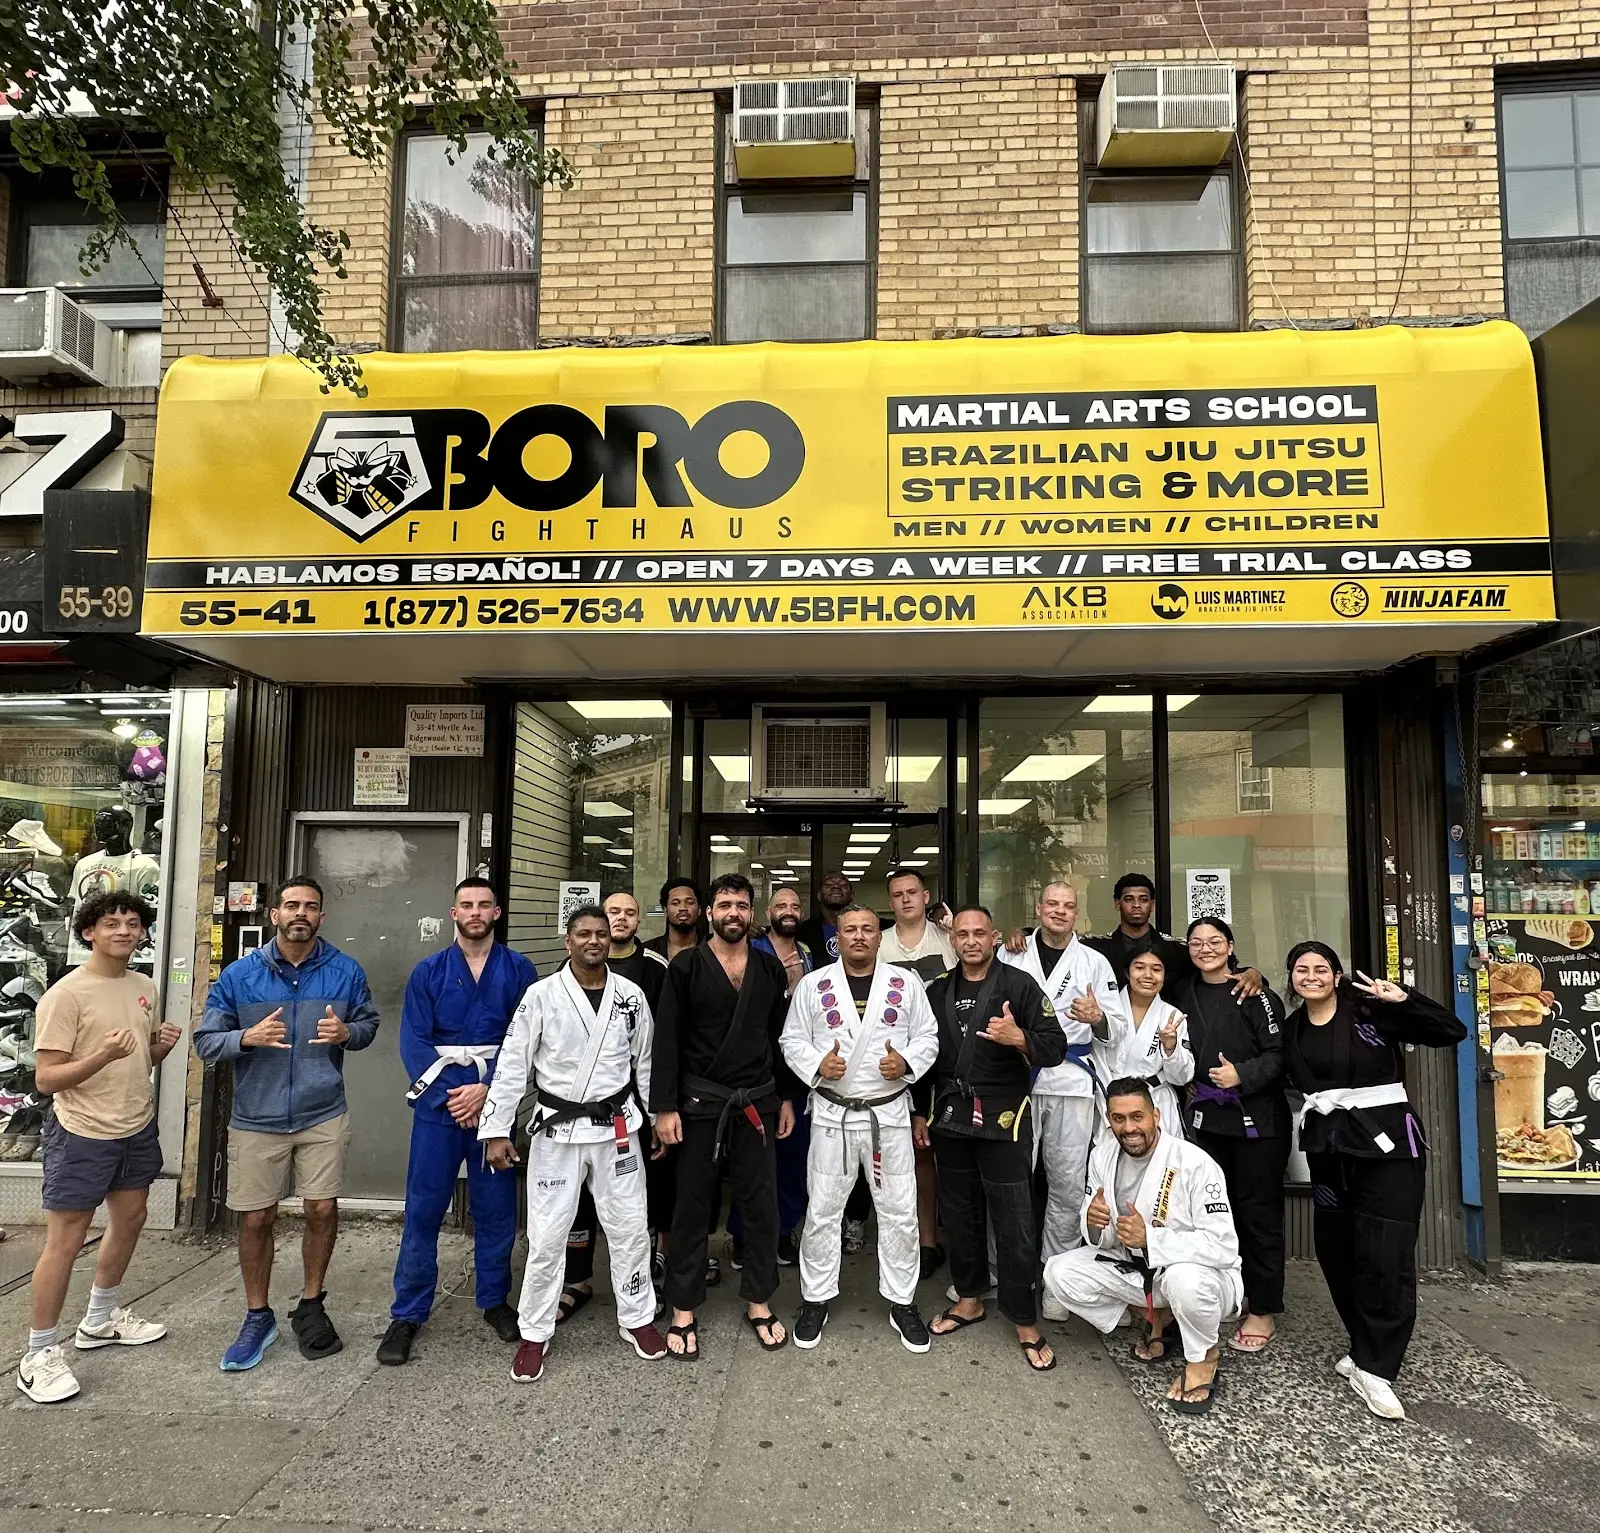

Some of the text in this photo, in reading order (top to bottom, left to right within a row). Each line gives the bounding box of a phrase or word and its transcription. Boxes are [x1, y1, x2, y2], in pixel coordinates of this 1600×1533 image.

[897, 394, 1367, 428] MARTIAL ARTS SCHOOL
[901, 437, 1366, 467] BRAZILIAN JIU JITSU
[901, 468, 1369, 503] STRIKING & MORE
[408, 516, 792, 544] FIGHTHAUS
[893, 520, 967, 537] MEN
[1020, 517, 1151, 535] WOMEN
[1204, 513, 1379, 532] CHILDREN
[205, 563, 400, 585] HABLAMOS
[411, 556, 581, 583] ESPAÑOL!
[635, 559, 735, 580] OPEN
[746, 559, 768, 579] 7
[779, 557, 875, 579] DAYS
[887, 557, 915, 577] A
[929, 554, 1042, 576] WEEK
[1102, 553, 1200, 574] FREE
[1213, 551, 1328, 573] TRIAL
[1340, 549, 1472, 571] CLASS
[59, 585, 134, 618] 55-39
[666, 594, 976, 623] WWW.5BFH.COM
[1194, 588, 1287, 606] LUIS MARTINEZ
[1384, 588, 1506, 609] NINJAFAM
[179, 599, 316, 626] 55-41
[363, 596, 645, 629] 1(877) 526-7634
[1021, 609, 1108, 620] ASSOCIATION
[410, 709, 485, 721] Quality Imports Ltd.
[437, 724, 460, 732] Myrtle
[26, 743, 101, 757] Welcome to
[801, 823, 812, 832] 55
